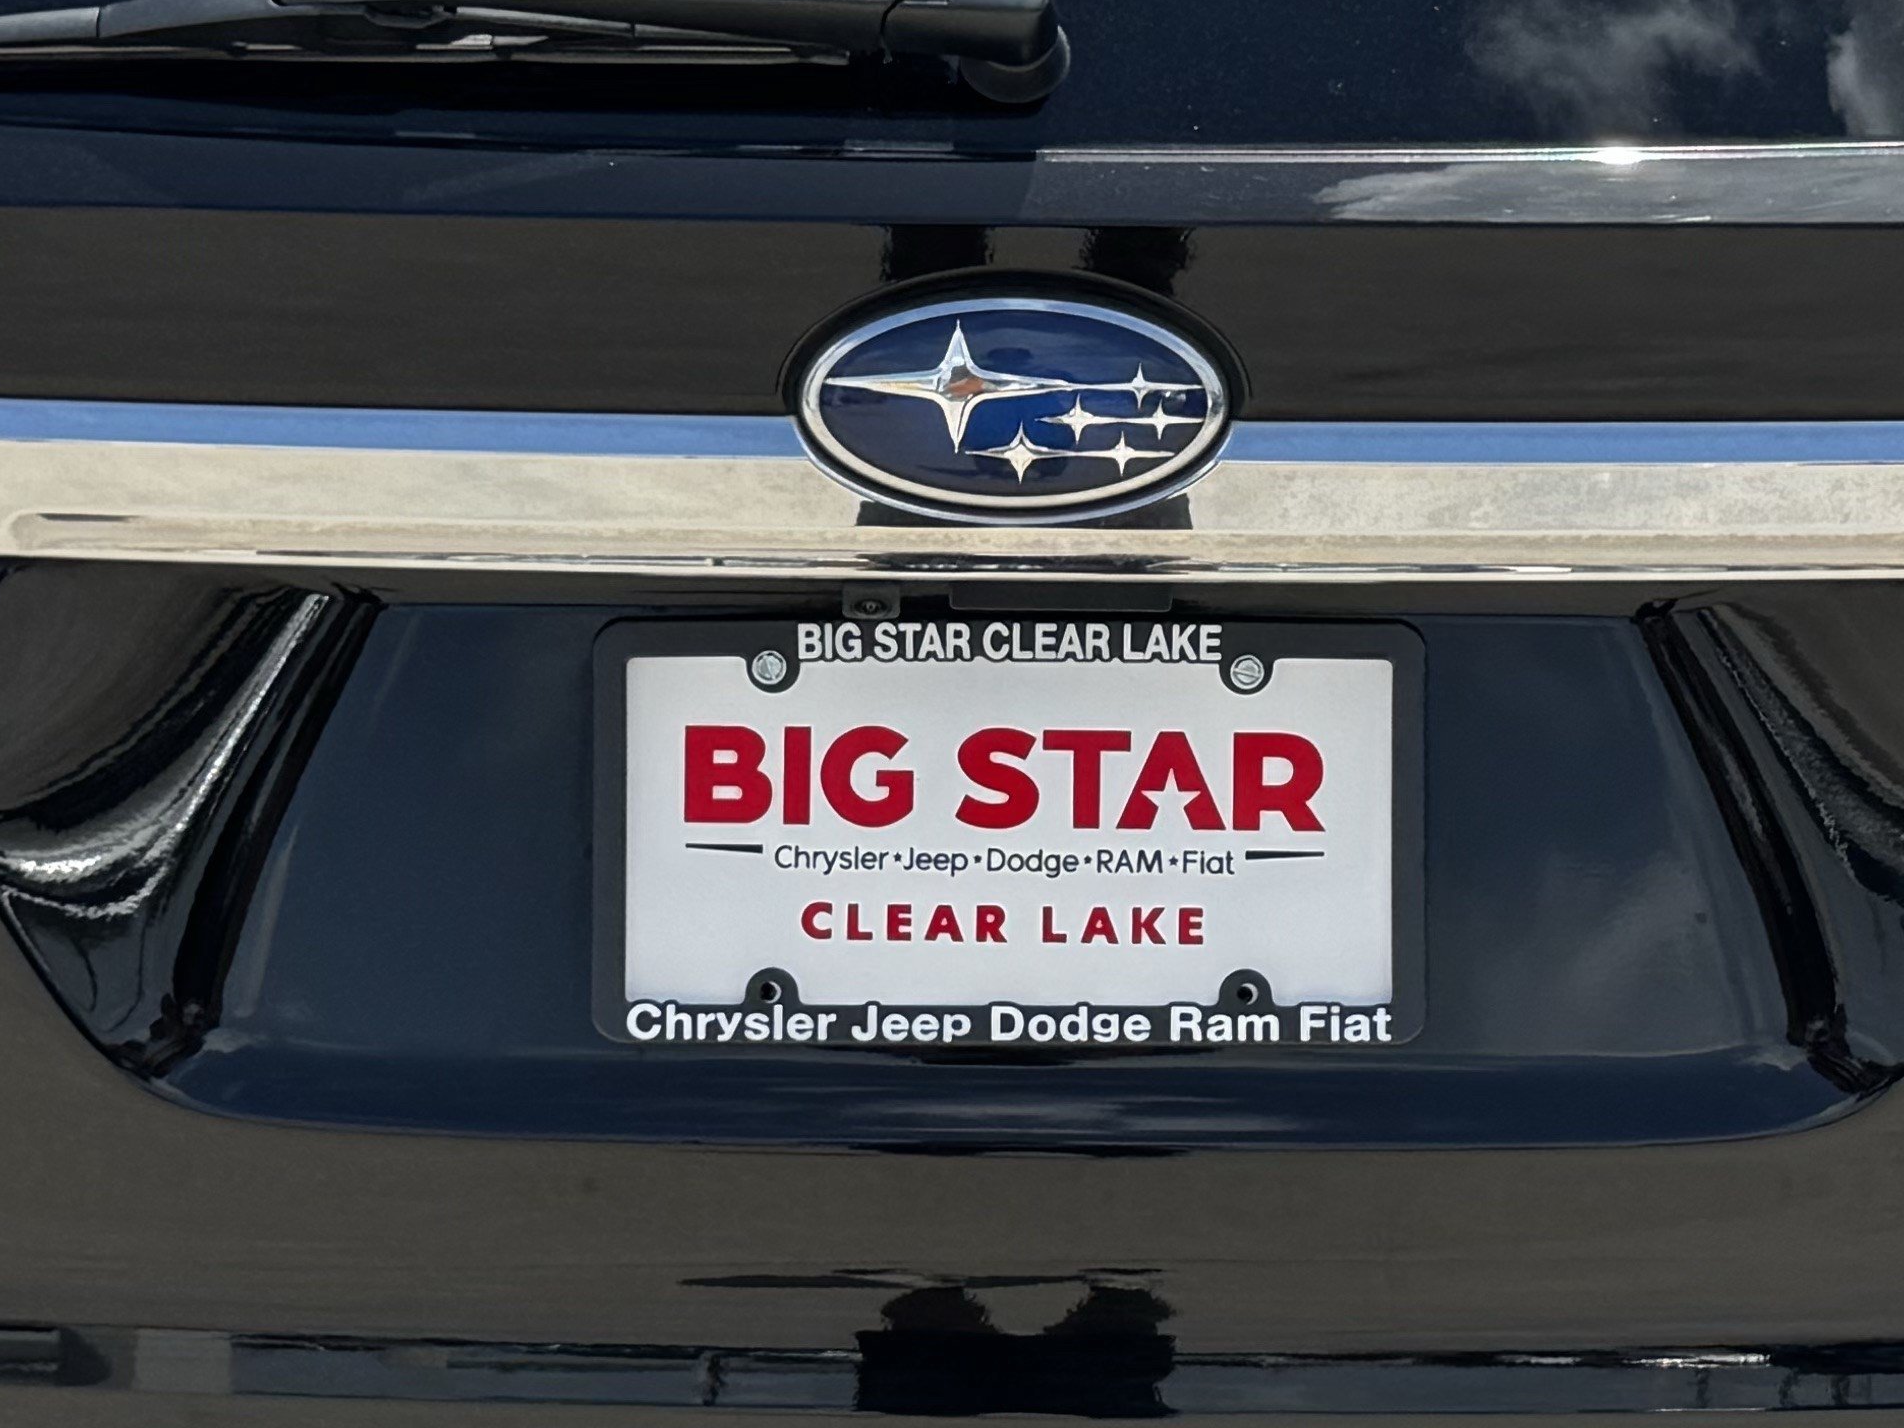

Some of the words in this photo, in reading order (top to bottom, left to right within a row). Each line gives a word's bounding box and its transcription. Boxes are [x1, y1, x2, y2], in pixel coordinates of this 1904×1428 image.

[797, 622, 863, 660] BIG
[873, 622, 971, 660] STAR
[982, 623, 1110, 661] CLEAR
[1123, 624, 1222, 662] LAKE
[683, 725, 915, 828] BIG
[955, 726, 1326, 832] STAR
[774, 844, 889, 875] Chrysler
[903, 847, 968, 877] Jeep
[987, 848, 1079, 878] Dodge
[1095, 850, 1162, 874] RAM
[1182, 850, 1235, 875] Fiat
[800, 901, 1008, 943] CLEAR
[1042, 906, 1205, 945] LAKE
[626, 1002, 837, 1042] Chrysler
[851, 1003, 972, 1043] Jeep
[990, 1005, 1152, 1043] Dodge
[1170, 1006, 1280, 1043] Ram
[1299, 1006, 1392, 1043] Fiat
